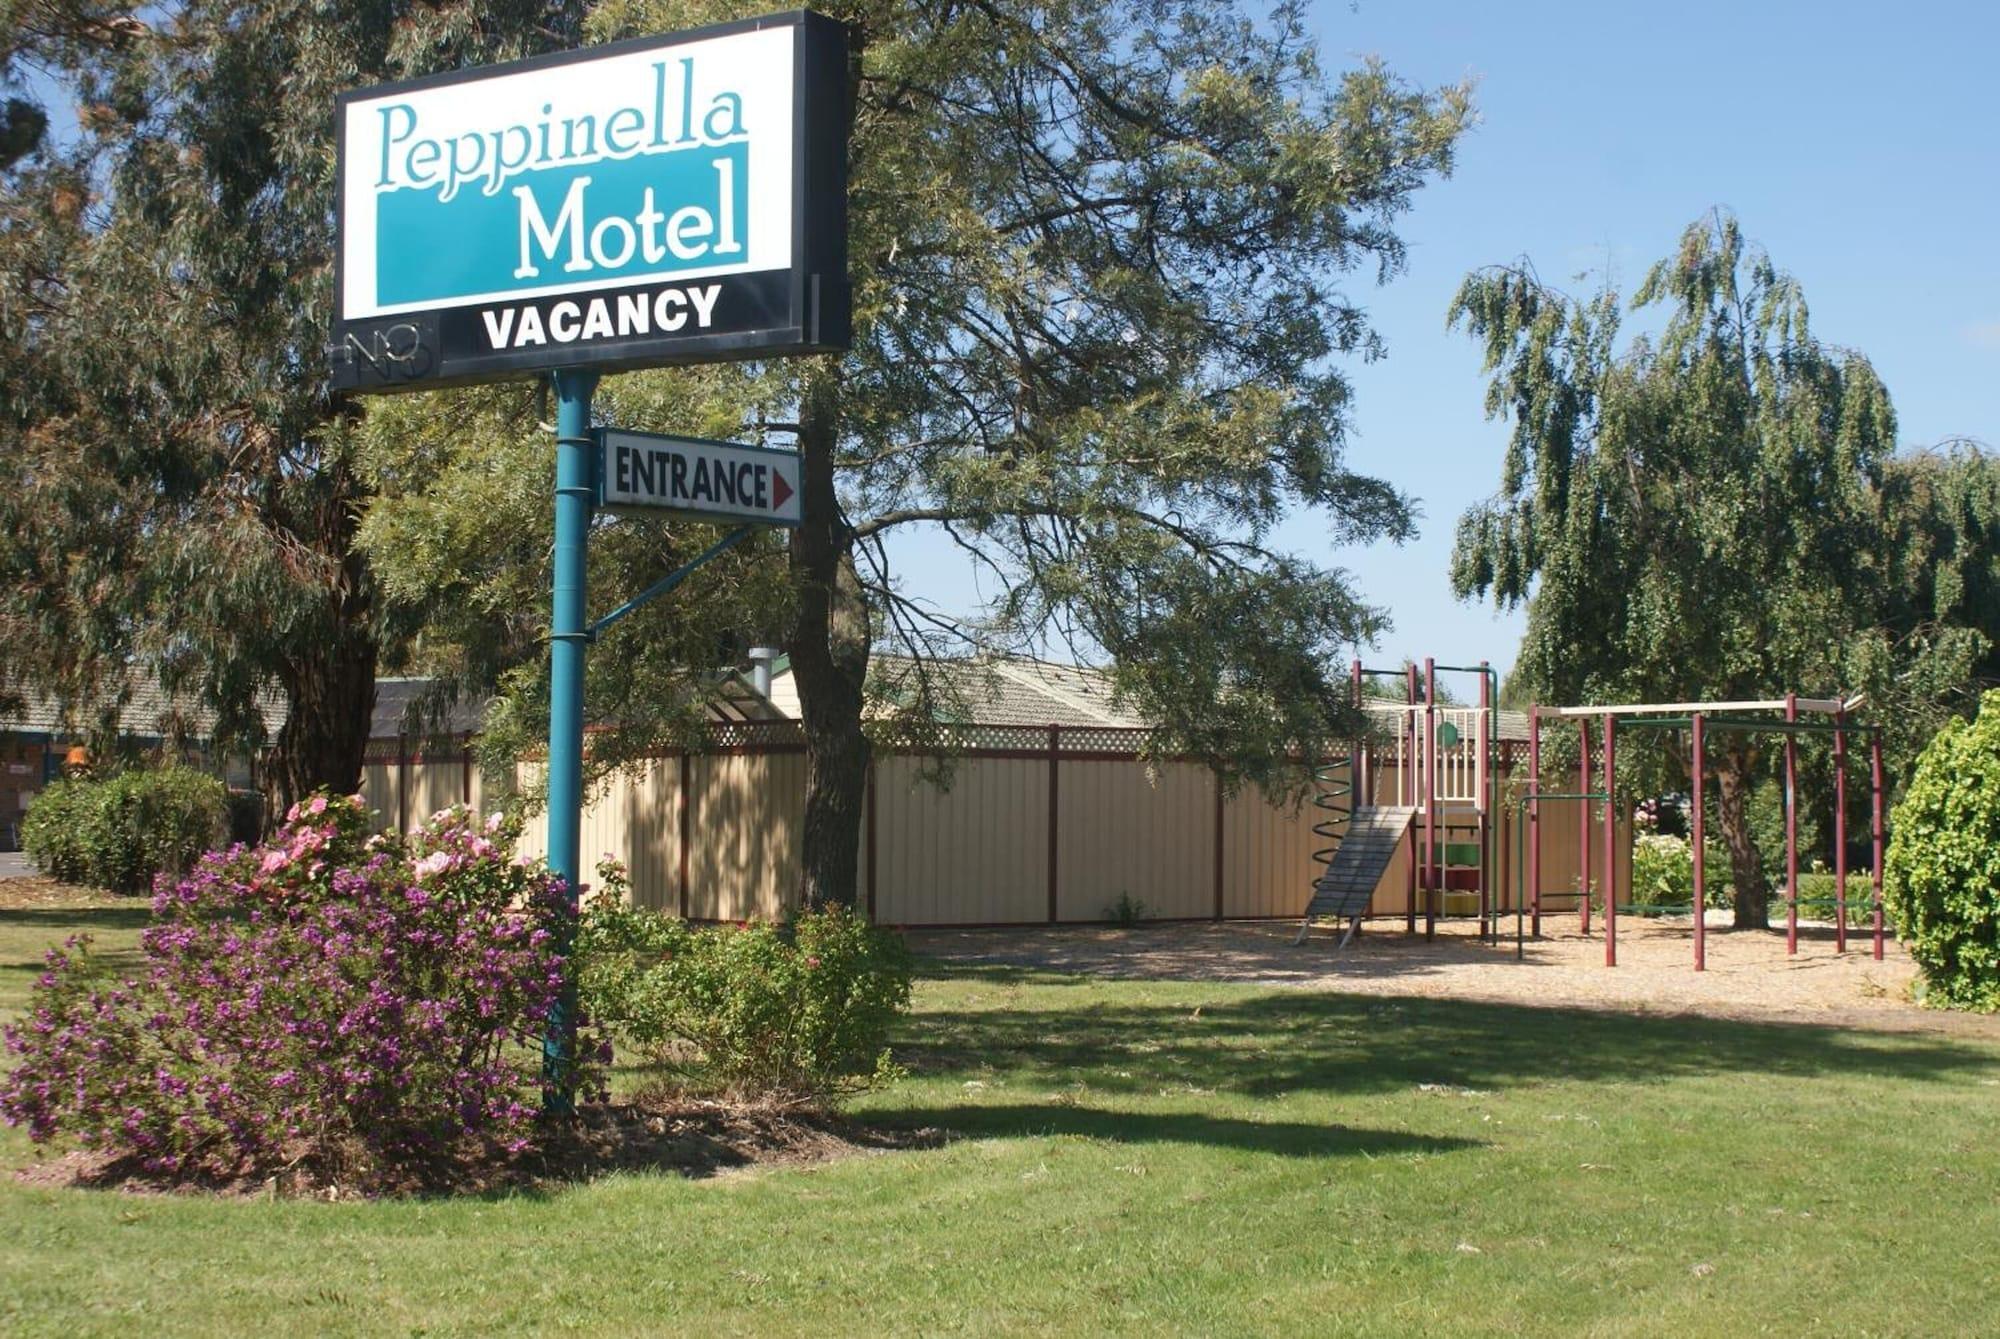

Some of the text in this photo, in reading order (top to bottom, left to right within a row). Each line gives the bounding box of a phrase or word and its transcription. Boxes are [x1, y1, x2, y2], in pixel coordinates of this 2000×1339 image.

[375, 57, 748, 198] Peppinella
[512, 158, 740, 279] Motel
[482, 285, 722, 349] VACANCY
[616, 446, 767, 508] ENTRANCE
